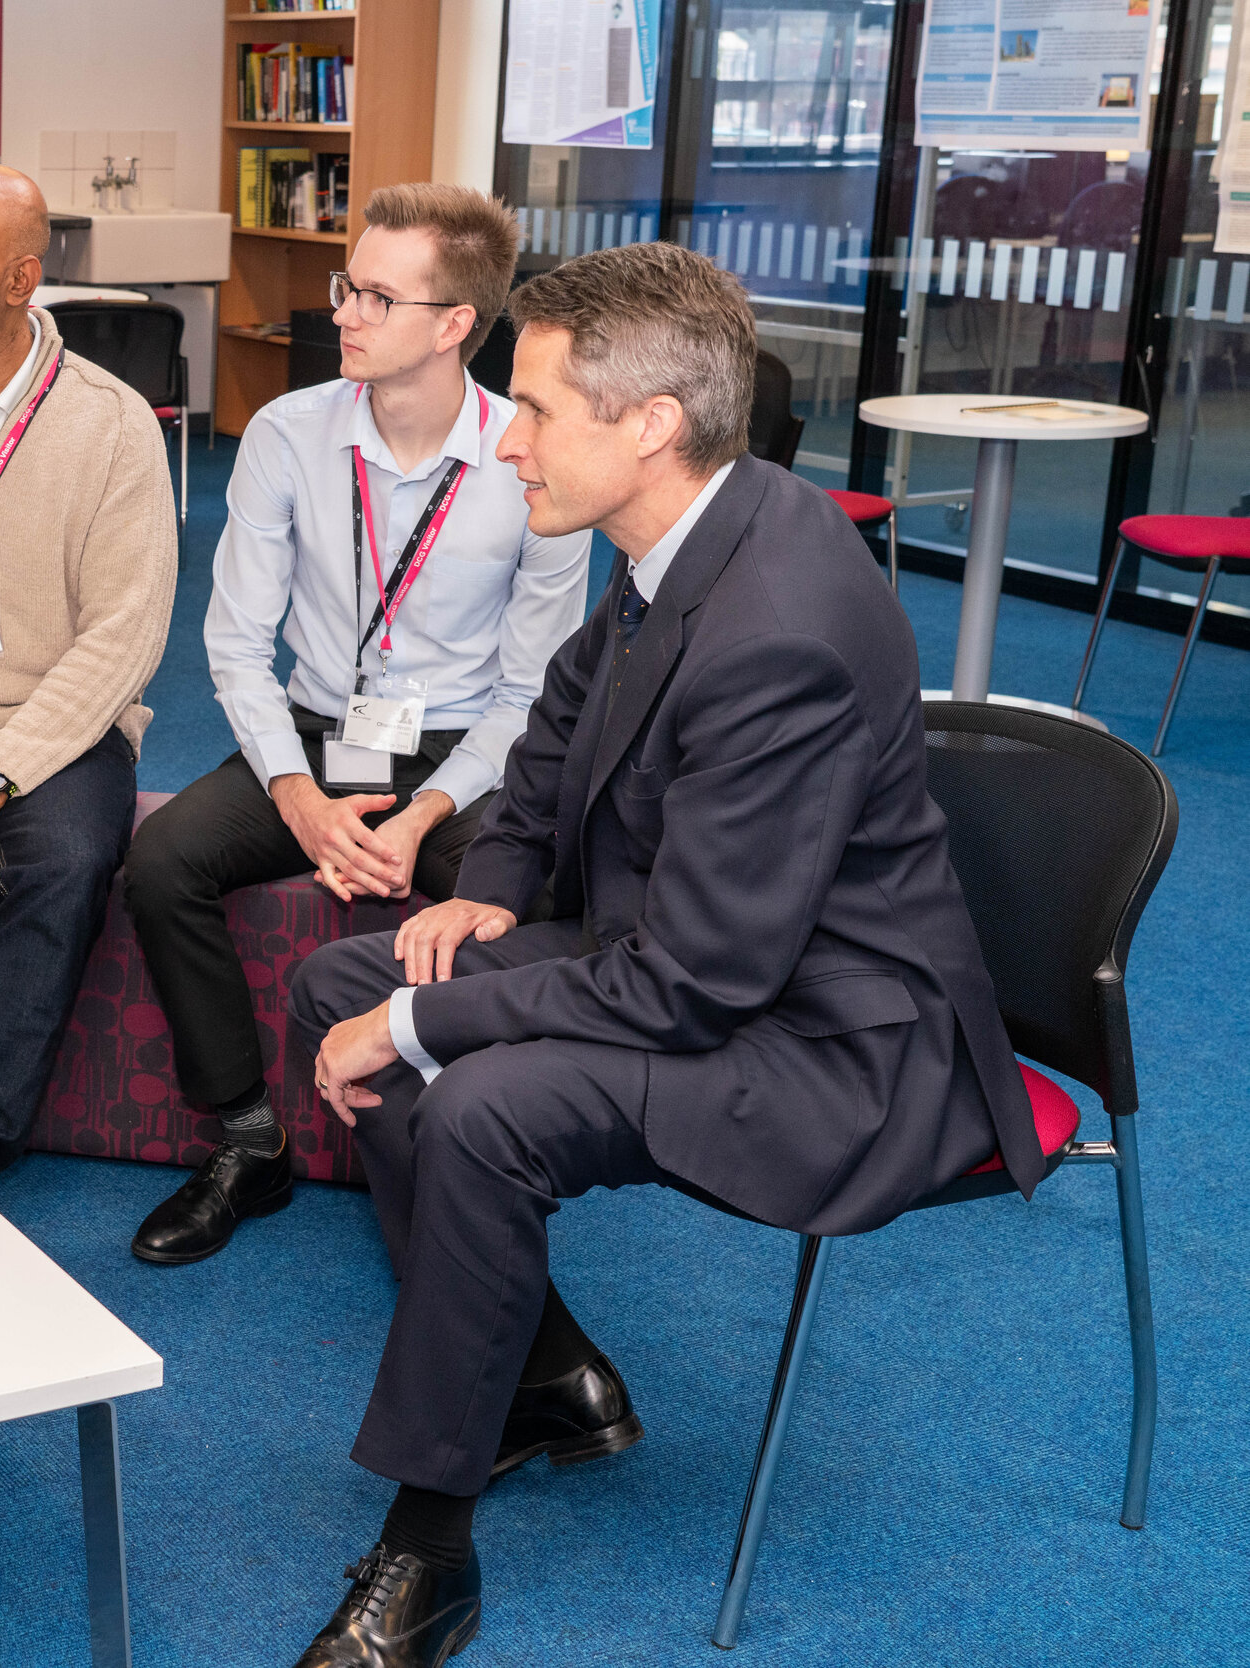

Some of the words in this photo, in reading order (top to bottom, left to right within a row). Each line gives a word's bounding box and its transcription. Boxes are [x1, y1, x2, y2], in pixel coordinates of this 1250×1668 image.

[0, 437, 16, 459] Visitor
[439, 494, 451, 512] DCG
[413, 551, 426, 568] DCG
[422, 526, 437, 550] Visitor
[395, 582, 410, 602] Visitor
